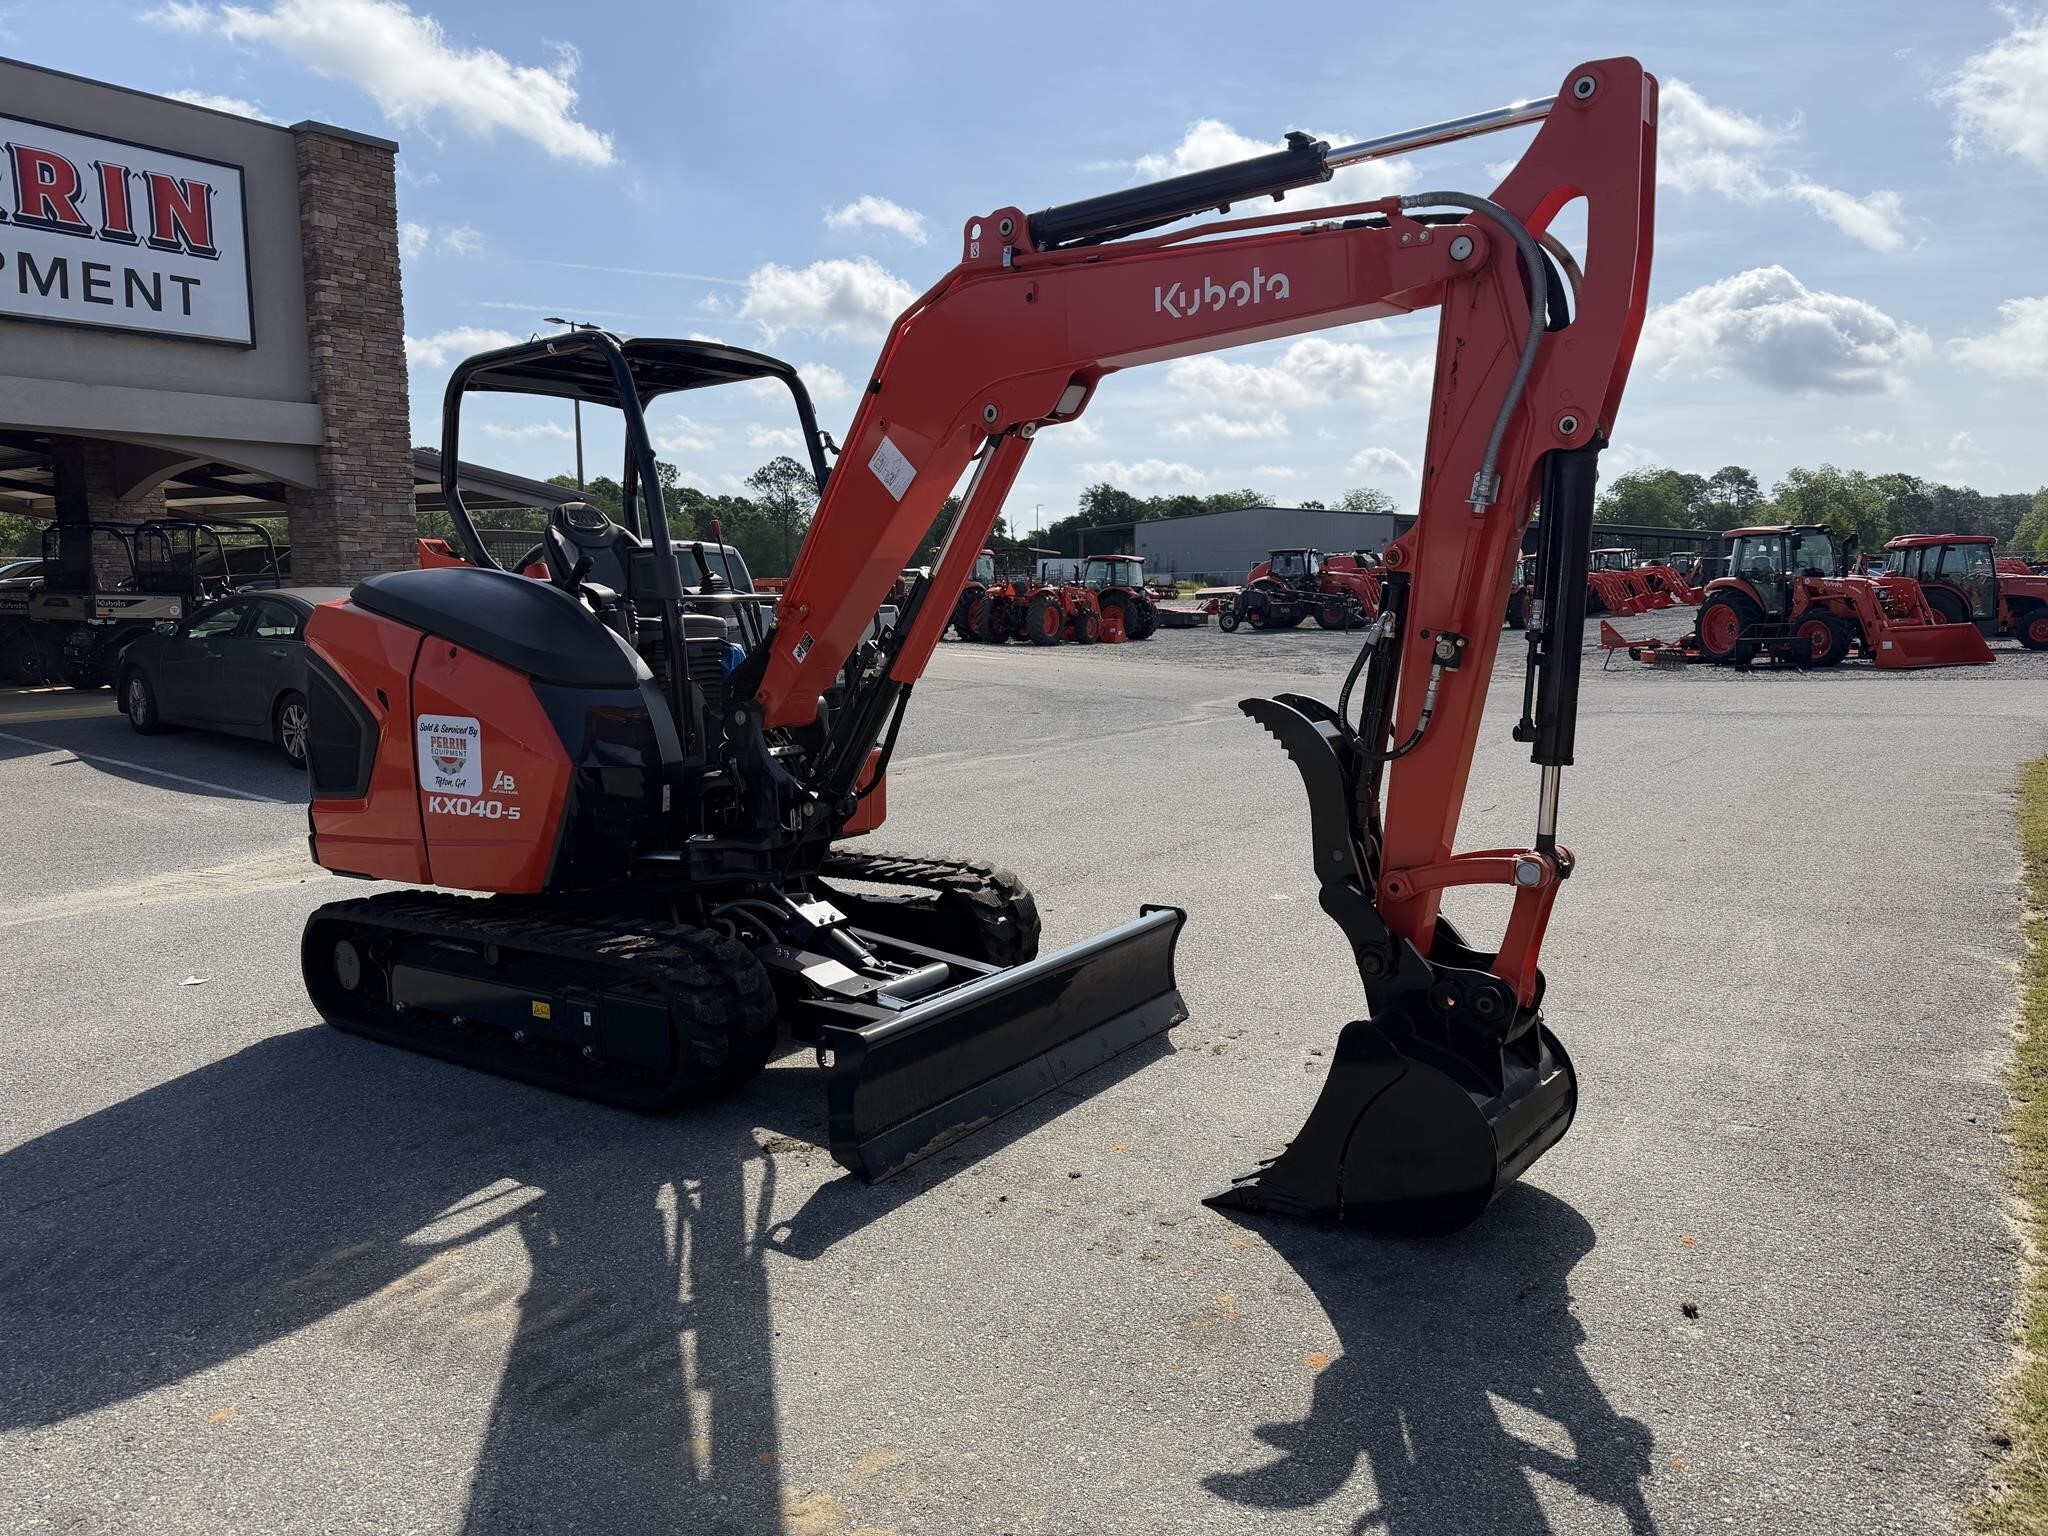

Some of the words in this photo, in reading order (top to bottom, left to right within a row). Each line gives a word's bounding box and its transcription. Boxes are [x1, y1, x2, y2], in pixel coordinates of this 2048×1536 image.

[0, 141, 222, 260] RIN
[0, 250, 201, 316] MENT
[1154, 266, 1290, 318] Kubota
[419, 722, 434, 732] Sold
[434, 723, 440, 733] &
[440, 724, 469, 735] Serviced
[468, 726, 479, 738] By
[430, 735, 467, 750] PERRIN
[431, 748, 467, 757] EQUIPMENT
[455, 778, 467, 789] GA
[428, 796, 521, 820] KX040-5
